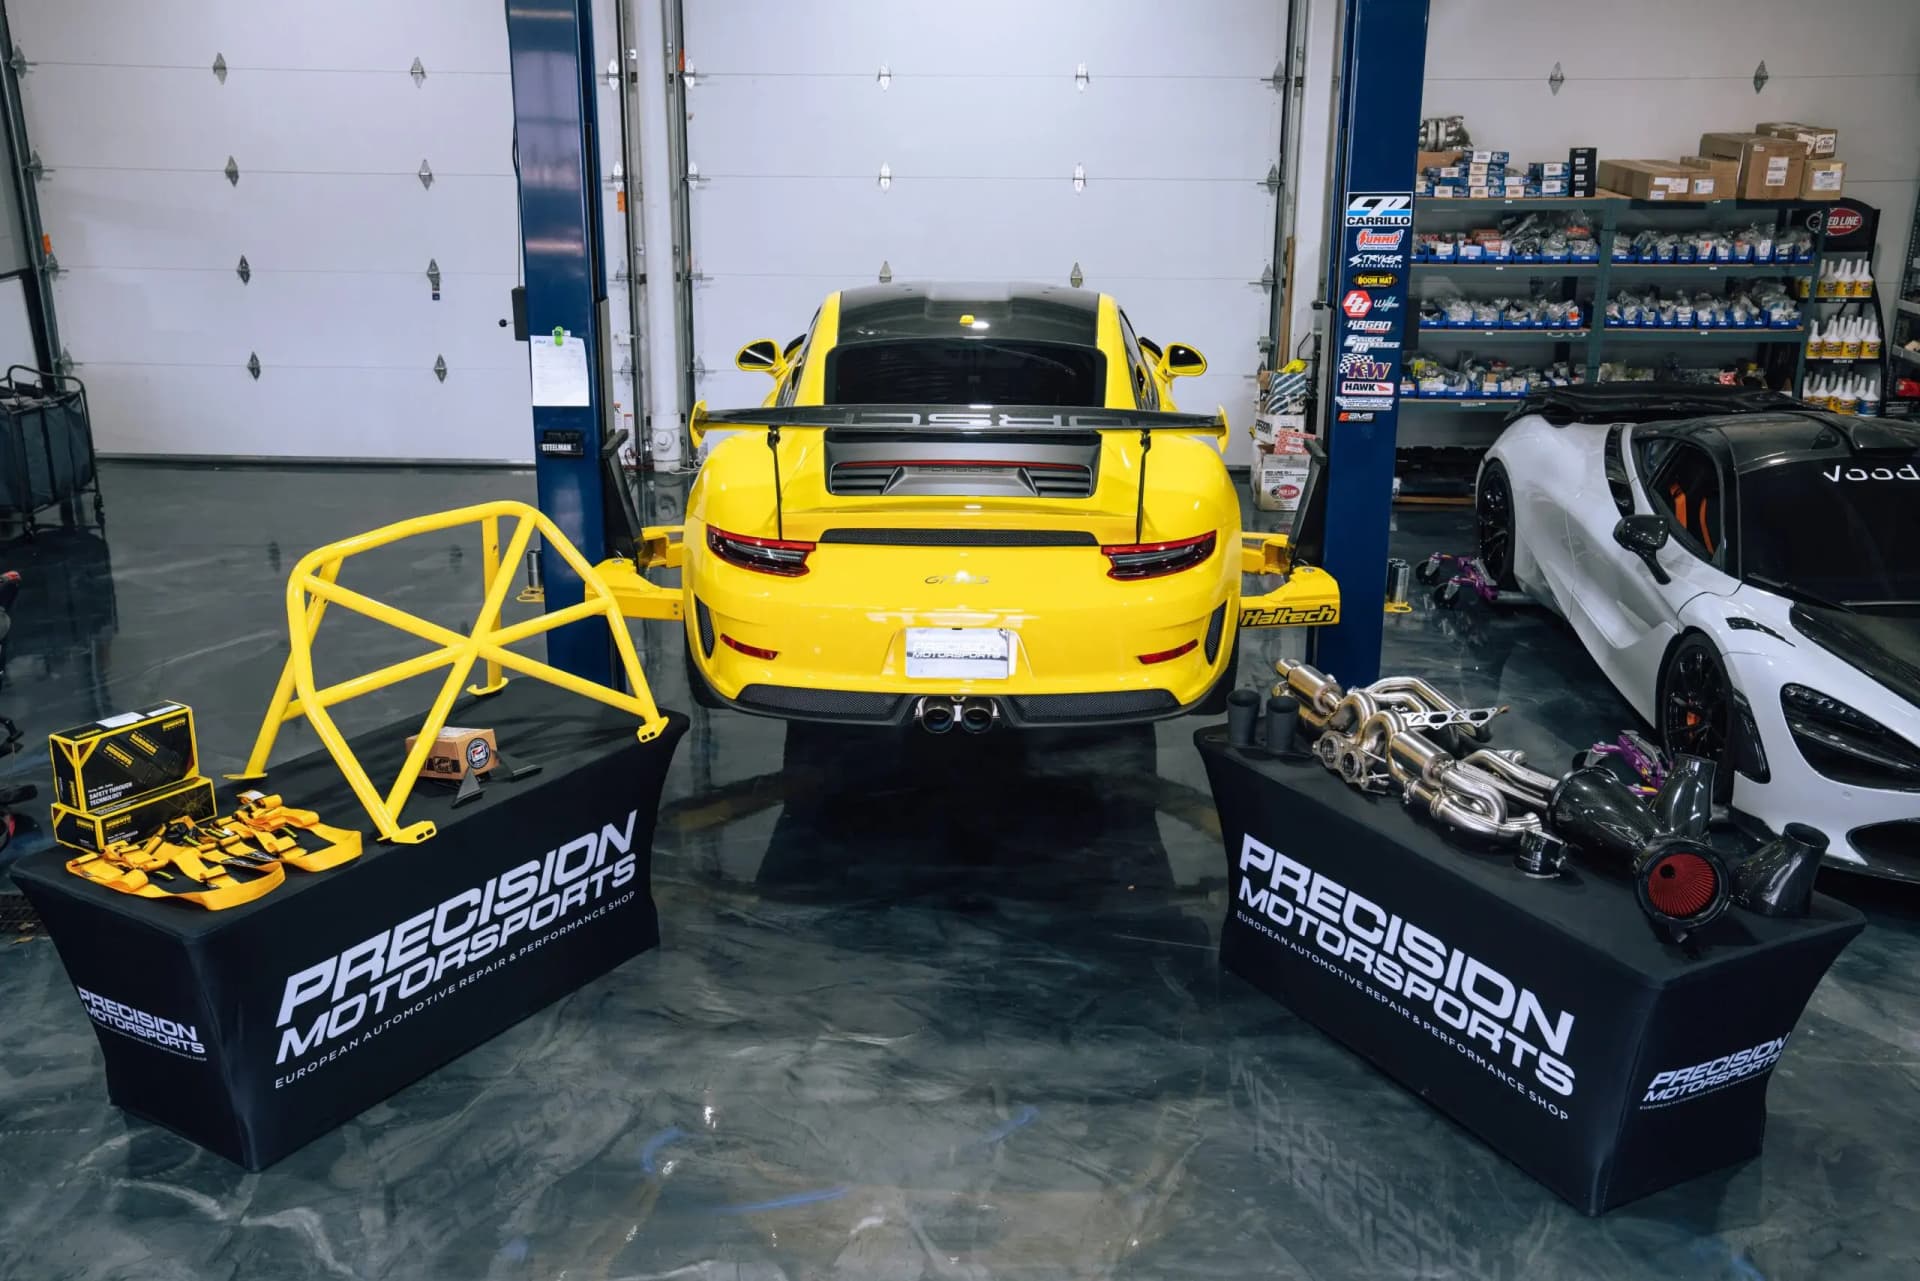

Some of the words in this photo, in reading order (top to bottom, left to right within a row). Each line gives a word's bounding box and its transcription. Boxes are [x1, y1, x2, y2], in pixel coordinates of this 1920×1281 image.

[1347, 216, 1410, 226] CARRILLO
[1349, 253, 1403, 267] STRYKER
[1345, 383, 1376, 391] HAWK
[1347, 362, 1392, 379] KW
[1241, 605, 1336, 626] Haltech
[275, 809, 638, 1028] PRECISION
[1239, 833, 1575, 1057] PRECISION
[275, 853, 636, 1065] MOTORSPORTS
[1238, 876, 1575, 1096] MOTORSPORTS
[77, 986, 198, 1042] PRECISION
[275, 1040, 359, 1089] EUROPEAN
[362, 985, 456, 1042] AUTOMOTIVE
[458, 958, 506, 989] REPAIR
[508, 953, 517, 962] &
[519, 906, 606, 957] PERFORMANCE
[607, 890, 635, 912] SHOP
[1236, 910, 1288, 946] EUROPEAN
[1290, 942, 1364, 990] AUTOMOTIVE
[1365, 985, 1410, 1020] REPAIR
[1412, 1015, 1421, 1025] &
[1423, 1021, 1526, 1095] PERFORMANCE
[1528, 1090, 1569, 1121] SHOP
[84, 1002, 206, 1054] MOTORSPORTS
[1642, 1050, 1783, 1102] MOTORSPORTS
[1647, 1031, 1791, 1089] PRECISION
